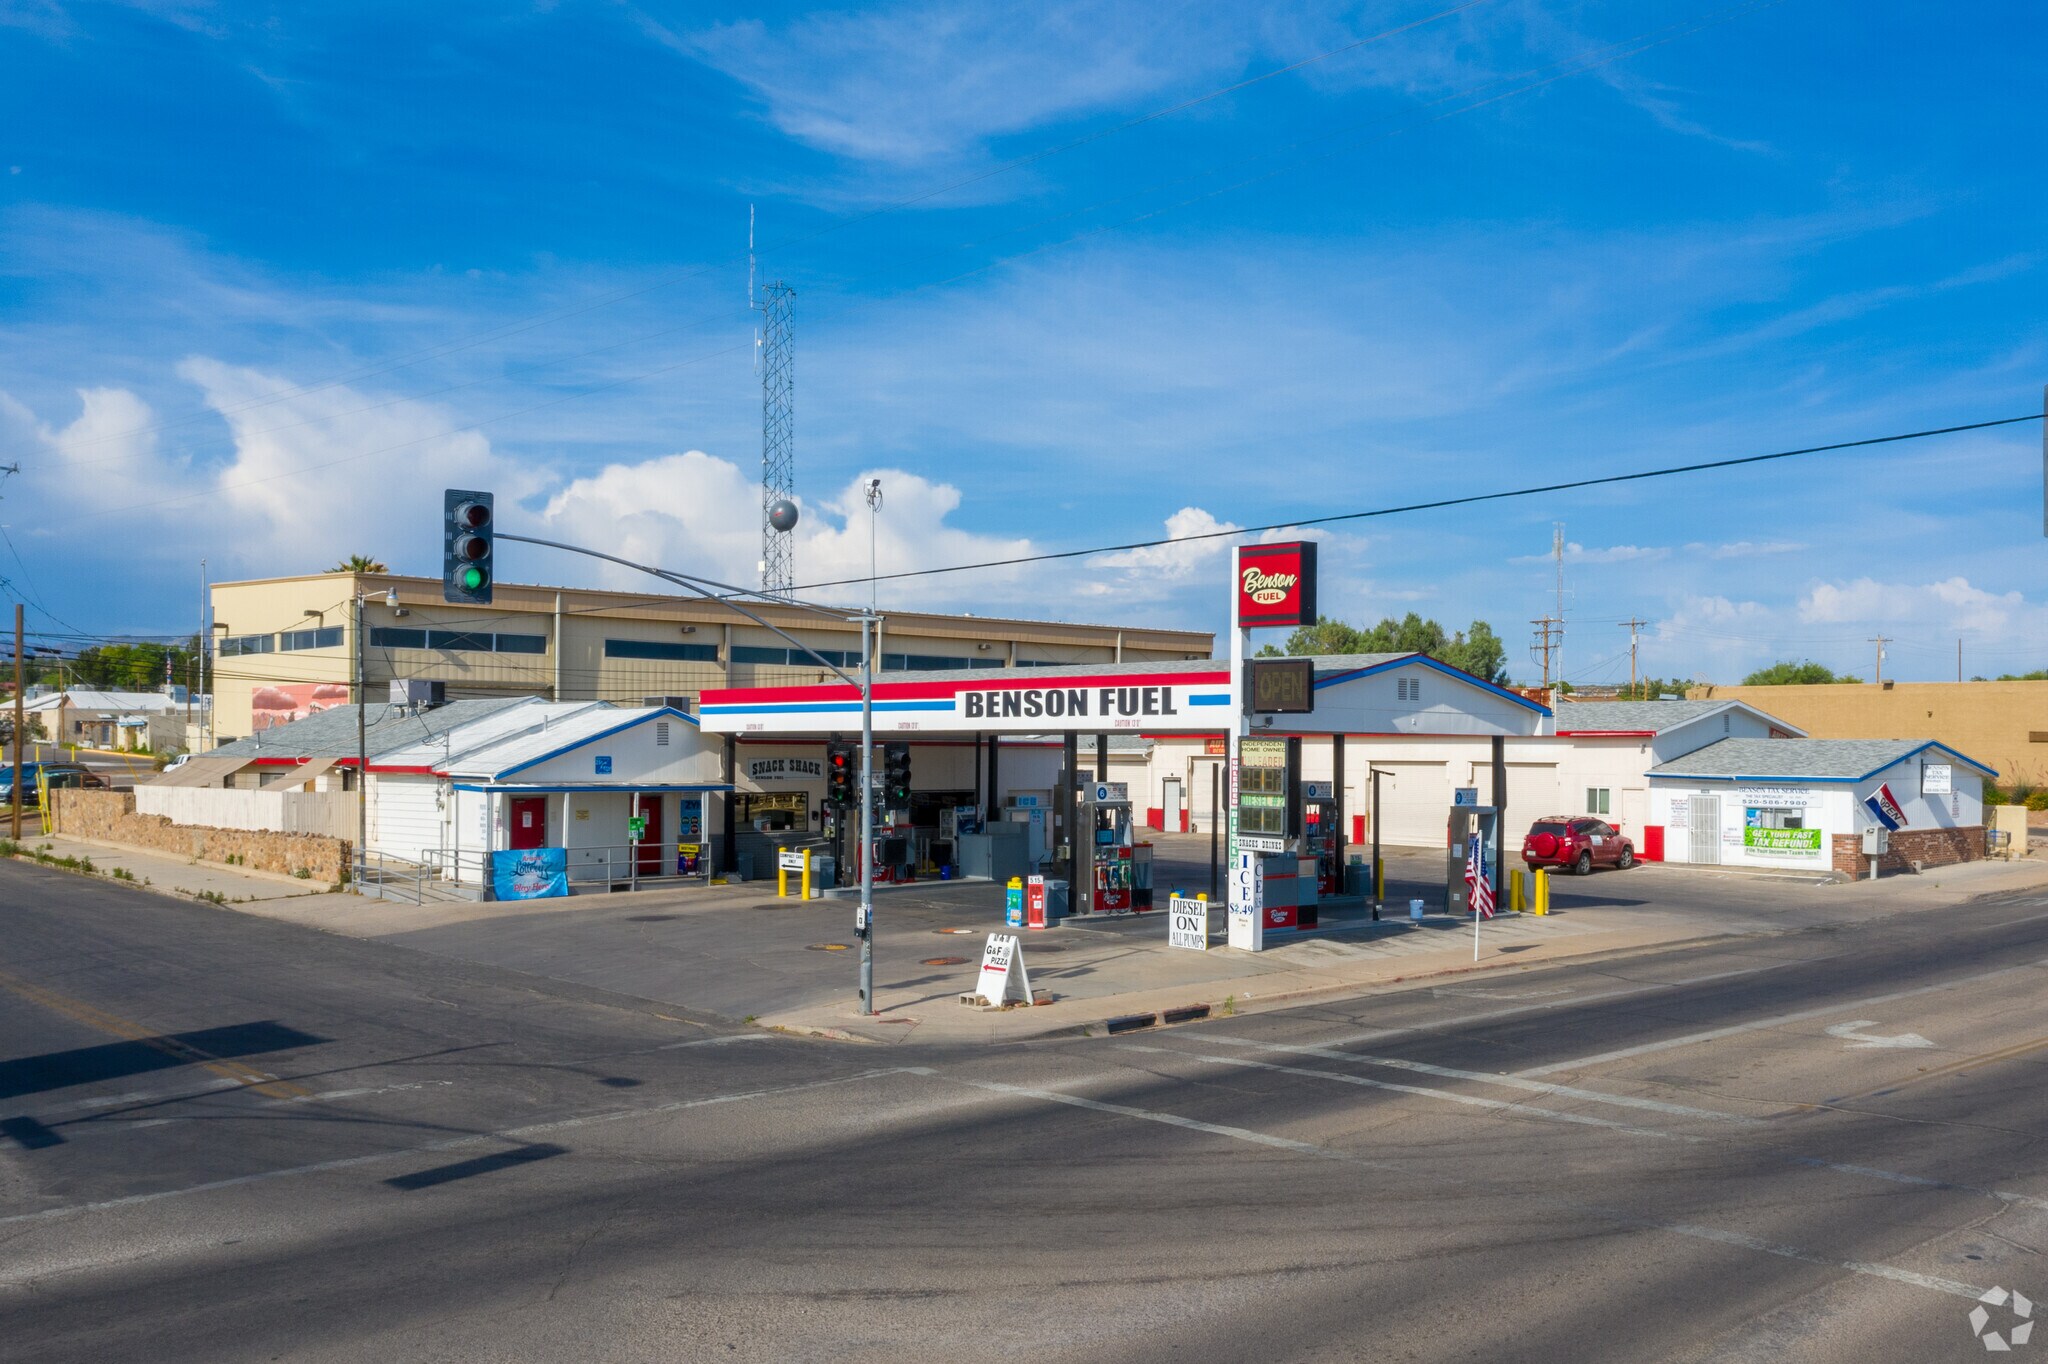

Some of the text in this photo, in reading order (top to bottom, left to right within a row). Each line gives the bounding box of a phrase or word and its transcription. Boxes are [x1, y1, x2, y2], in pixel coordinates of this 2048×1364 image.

[1242, 567, 1298, 593] Benson
[1257, 593, 1281, 601] FUEL
[1259, 671, 1303, 701] OPEN
[965, 687, 1177, 718] BENSON FUEL
[752, 759, 820, 776] SNACK SHACK
[1241, 756, 1283, 767] UNLEADED
[1780, 787, 1810, 795] SERVICE
[1241, 795, 1268, 806] DIESEL
[1880, 797, 1901, 820] OPEN
[1752, 829, 1768, 838] GET
[1770, 830, 1790, 838] YOUR
[1793, 831, 1813, 839] FAST
[1239, 839, 1281, 850] SNACKS DRINKS
[1753, 838, 1813, 848] TAX REFUND!
[509, 860, 547, 880] Lottery
[1240, 855, 1250, 901] ICE
[514, 884, 530, 893] Play
[1172, 900, 1205, 916] DIESEL
[1229, 903, 1254, 916] $2.49
[1176, 916, 1198, 931] ON
[1172, 932, 1204, 949] ALL PUMPS
[986, 945, 1003, 956] G&F
[990, 957, 1008, 966] PIZZA
